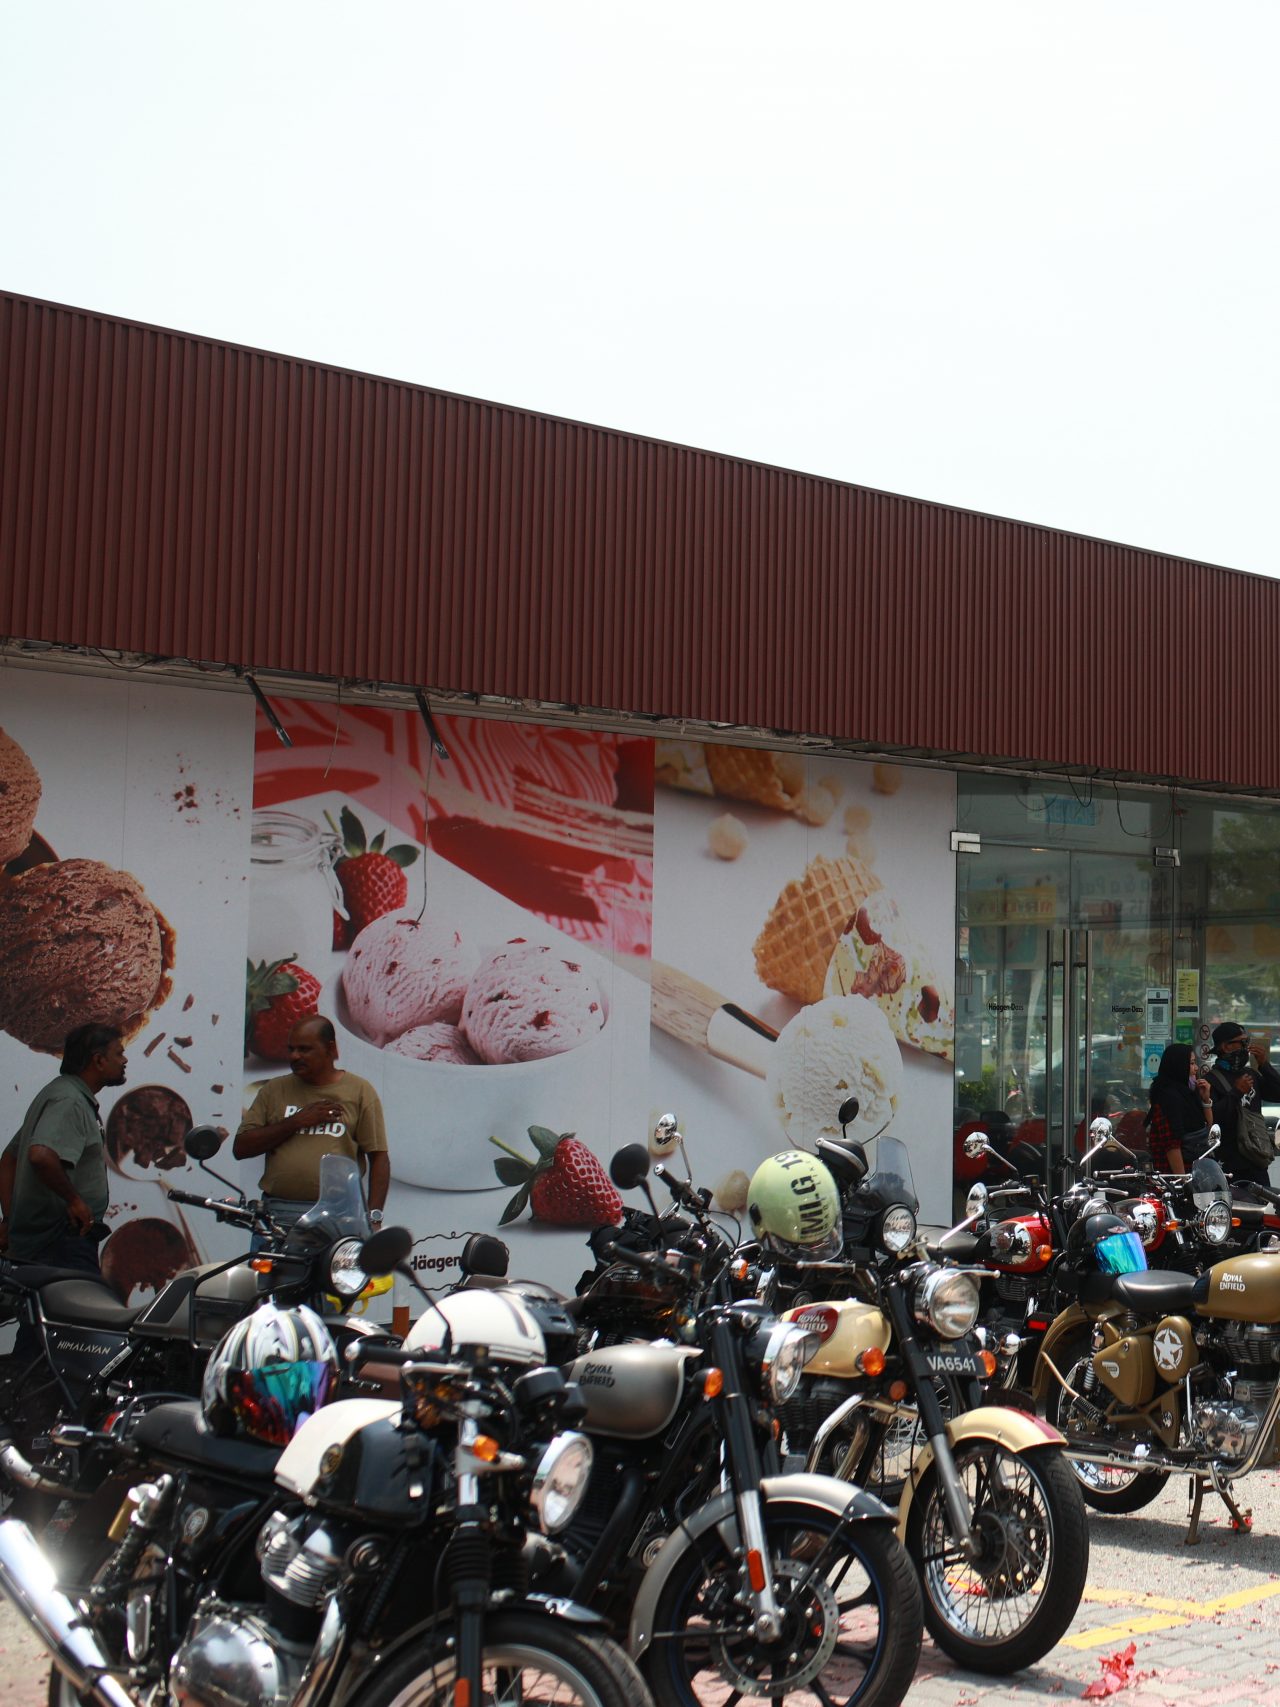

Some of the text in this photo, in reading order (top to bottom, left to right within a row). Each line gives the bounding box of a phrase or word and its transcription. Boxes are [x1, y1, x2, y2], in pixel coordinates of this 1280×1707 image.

[988, 1002, 1024, 1013] Häagen-Dazs
[1222, 1272, 1244, 1282] ROYAL
[1219, 1281, 1246, 1292] ENFIELD
[797, 1314, 826, 1322] ROYAL
[56, 1340, 112, 1355] HIMALAYAN
[583, 1362, 614, 1375] ROYAL
[926, 1355, 976, 1373] VA6541
[578, 1374, 616, 1388] ENFIELD
